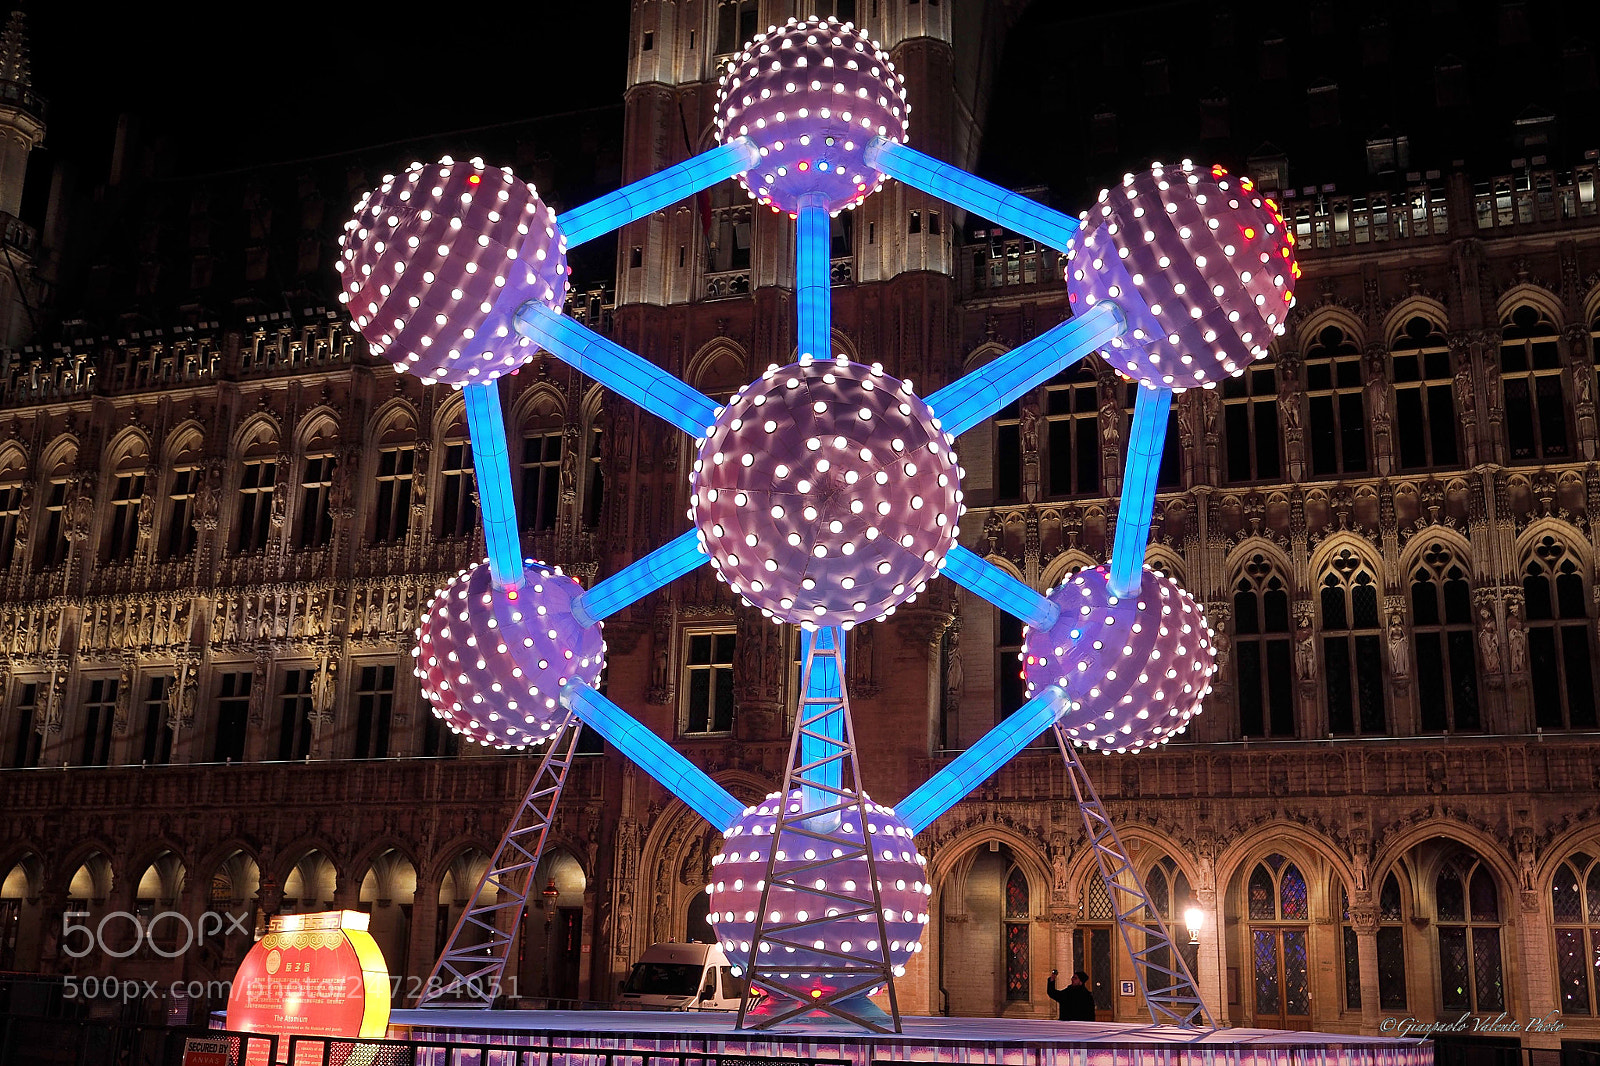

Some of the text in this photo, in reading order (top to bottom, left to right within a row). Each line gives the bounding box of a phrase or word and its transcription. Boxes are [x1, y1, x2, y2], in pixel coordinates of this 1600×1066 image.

[274, 1014, 308, 1023] The Atomium
[188, 1041, 229, 1054] SECURED BY
